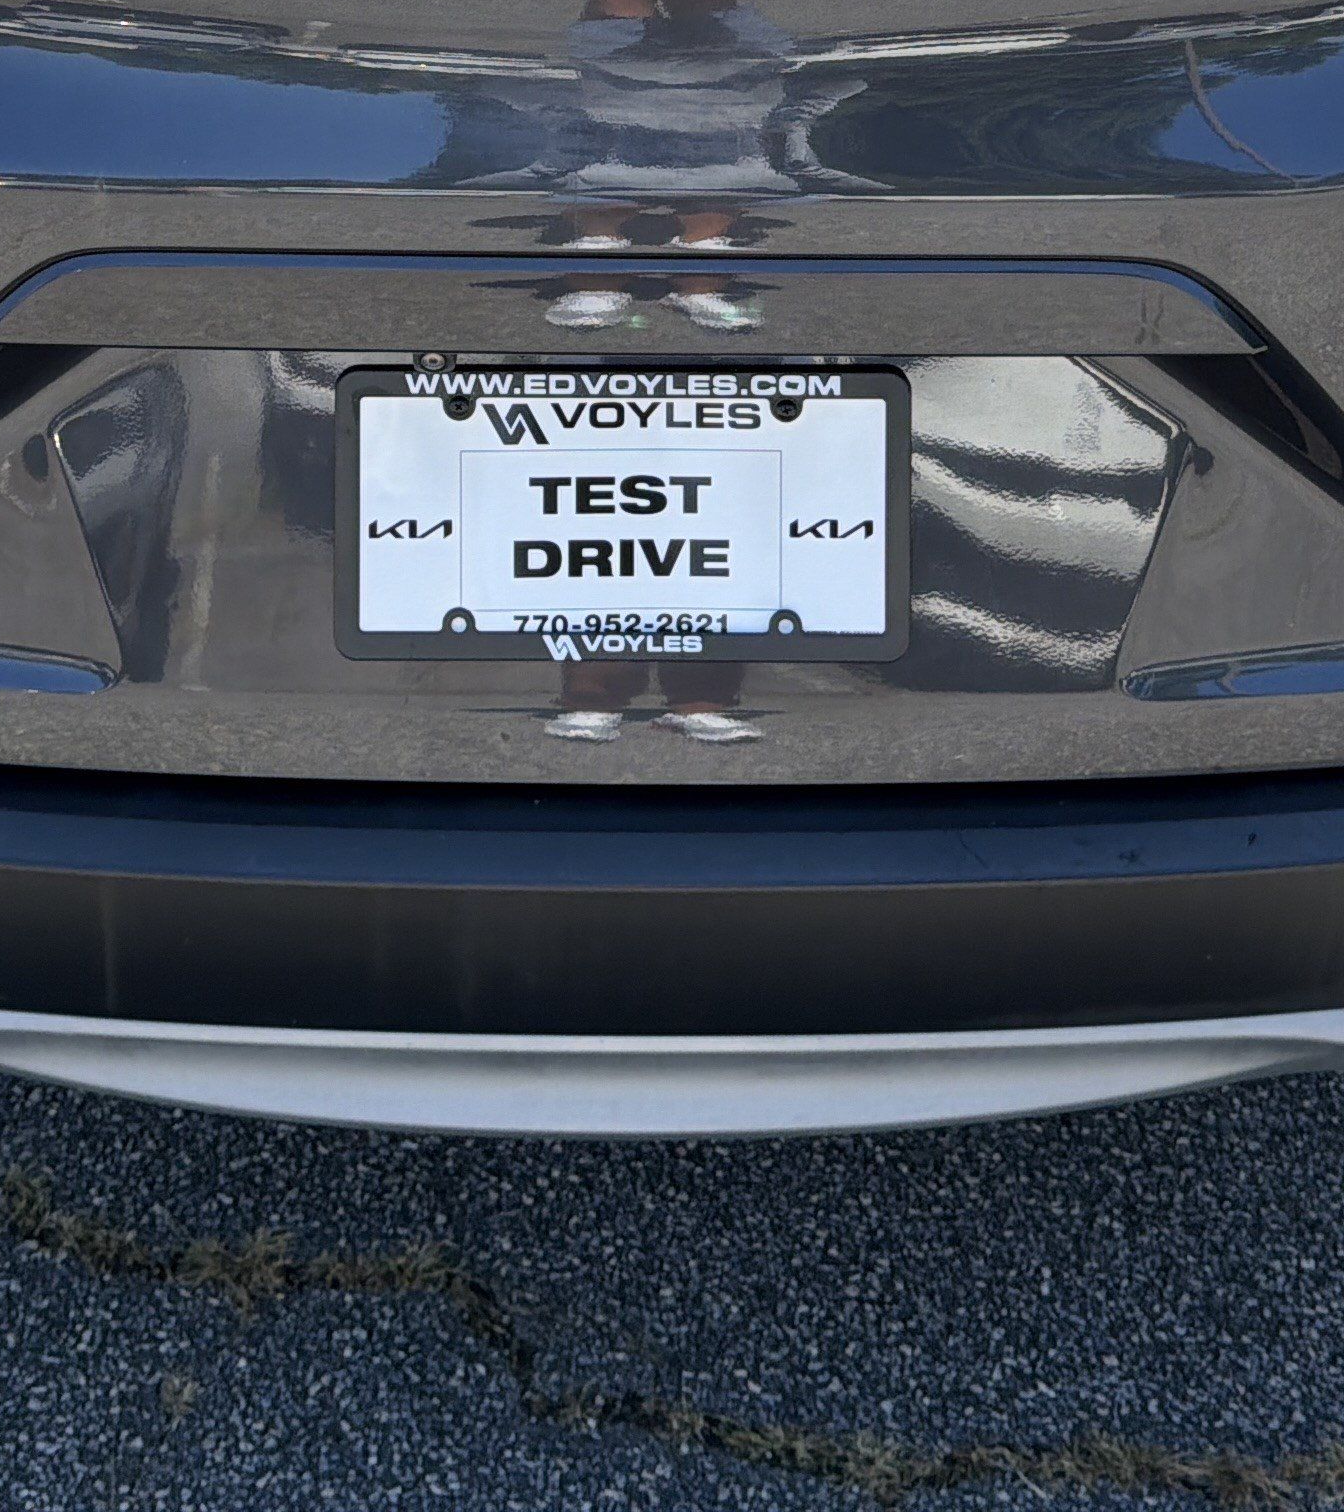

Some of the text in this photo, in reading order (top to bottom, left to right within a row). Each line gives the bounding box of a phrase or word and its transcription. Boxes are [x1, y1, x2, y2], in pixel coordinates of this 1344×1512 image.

[404, 374, 842, 396] WWW.EDVOYLES.COM
[551, 402, 762, 429] VOYLES
[529, 475, 712, 515] TEST
[513, 538, 731, 579] DRIVE
[513, 613, 729, 633] 770-952-2621
[581, 635, 703, 653] VOYLES
